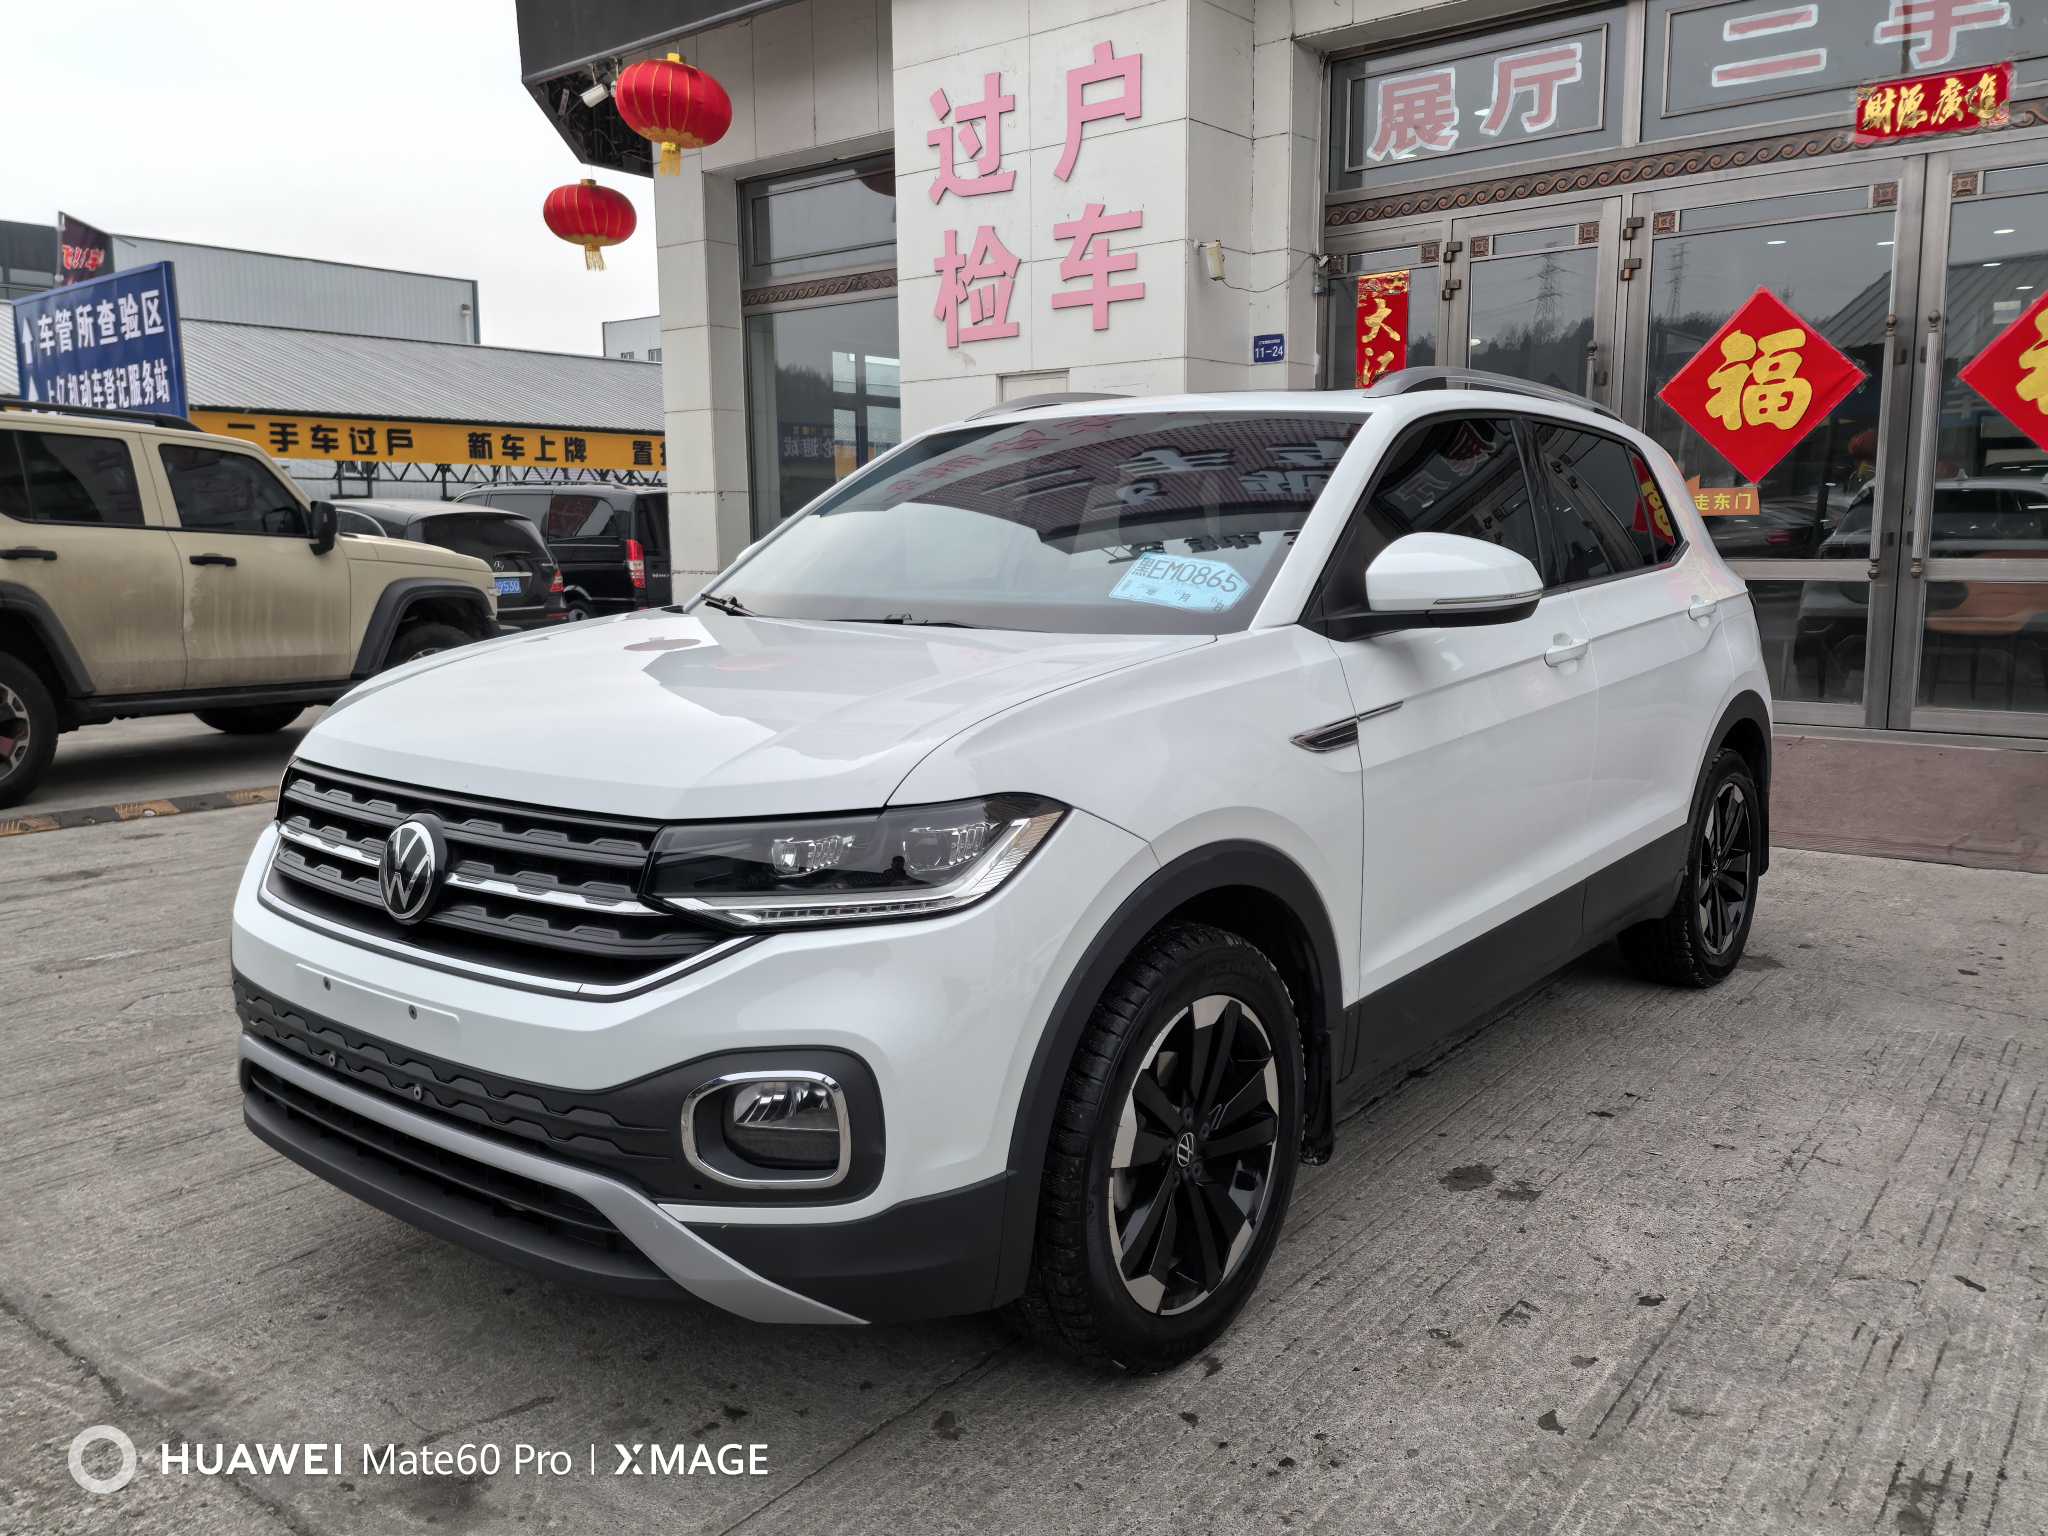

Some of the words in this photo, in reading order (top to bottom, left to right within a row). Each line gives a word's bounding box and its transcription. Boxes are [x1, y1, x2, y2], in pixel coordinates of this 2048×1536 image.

[927, 40, 1143, 205] 过户
[1366, 42, 1583, 162] 展厅
[933, 203, 1146, 348] 检车
[38, 289, 166, 356] 车管所查验区
[1255, 345, 1284, 359] 11-24
[1705, 328, 1813, 431] 福
[467, 432, 587, 463] 新车上牌
[1694, 492, 1752, 511] 走东门
